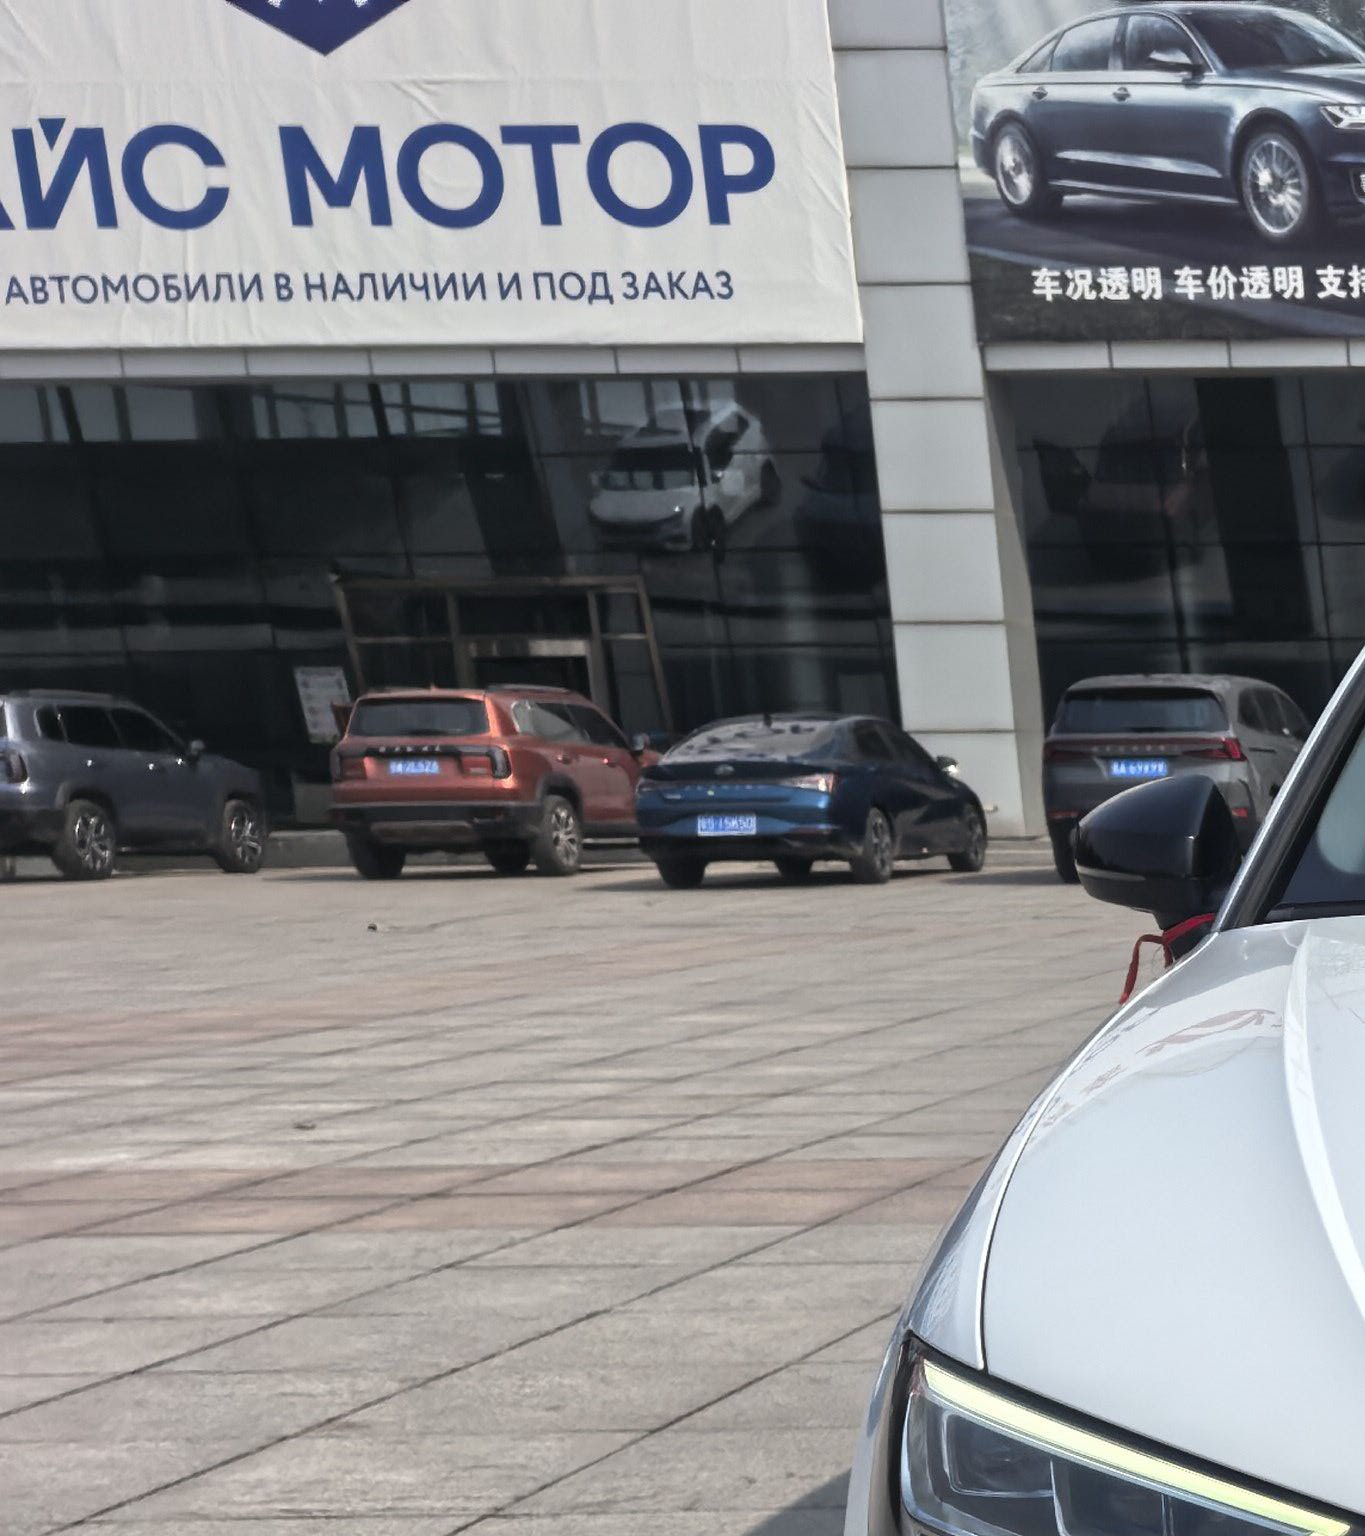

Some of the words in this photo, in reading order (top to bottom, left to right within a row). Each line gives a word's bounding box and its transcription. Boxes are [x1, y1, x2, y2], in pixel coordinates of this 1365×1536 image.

[0, 117, 230, 231] ЙС
[278, 122, 776, 230] МОТОР
[5, 272, 264, 304] АВТОМОБИЛИ
[275, 272, 294, 302] В
[304, 271, 487, 302] НАЛИЧИИ
[498, 271, 523, 301] И
[532, 271, 615, 304] ПОД
[621, 270, 735, 301] ЗАКАЗ
[1031, 265, 1163, 302] 车况透明
[1174, 265, 1305, 301] 车价透明
